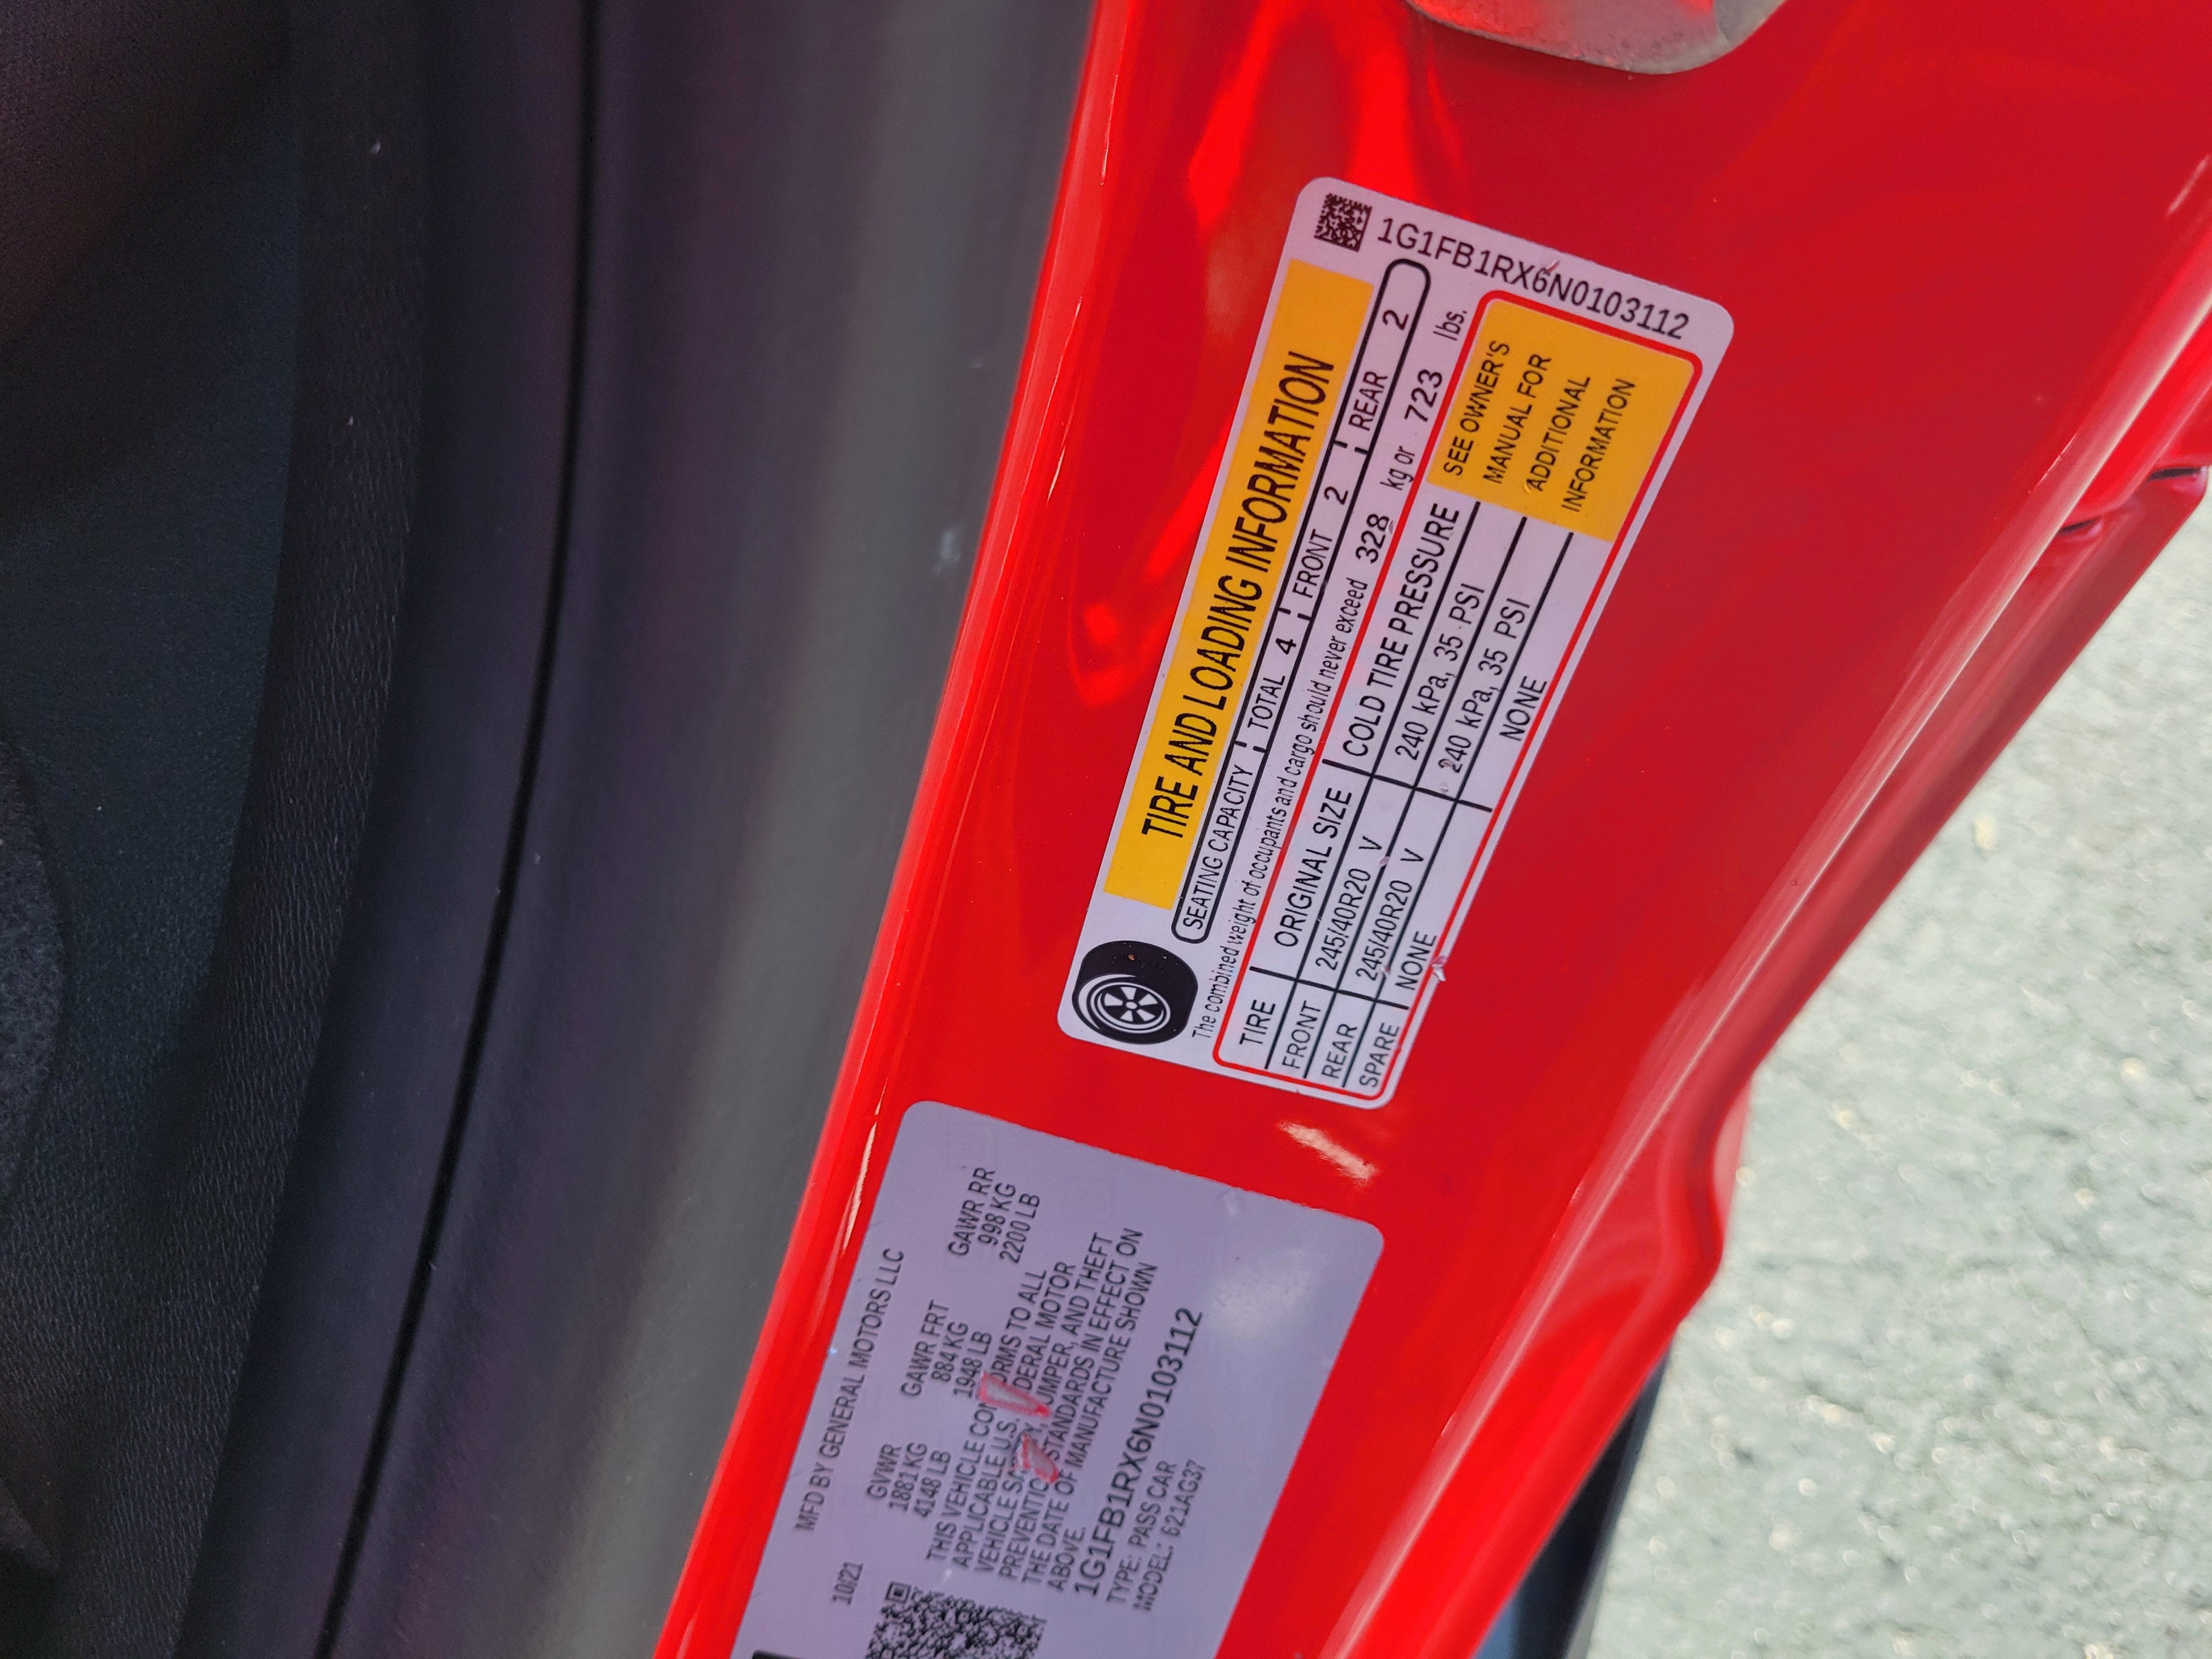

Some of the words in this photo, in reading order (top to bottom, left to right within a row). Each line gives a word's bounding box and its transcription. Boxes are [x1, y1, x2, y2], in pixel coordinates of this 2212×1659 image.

[1378, 218, 1689, 340] 1G1FB1RX6N0103112
[1433, 311, 1467, 341] lbs.
[1348, 371, 1388, 431] REAR
[1383, 310, 1409, 330] 2
[1404, 369, 1442, 422] 723
[1443, 437, 1474, 476] SEE
[1460, 341, 1509, 432] OWNER'S
[1483, 405, 1532, 484] MANUAL
[1517, 354, 1551, 398] FOR
[1526, 377, 1590, 491] ADDITIONAL
[1226, 351, 1334, 572] INFORMATION
[1394, 446, 1415, 464] or
[1561, 379, 1635, 512] INFORMATION
[1380, 469, 1413, 490] kg
[1293, 529, 1332, 598] FRONT
[1324, 487, 1348, 505] 2
[1356, 514, 1392, 563] 328
[1335, 578, 1368, 633] exceed
[1343, 696, 1385, 756] COLD
[1367, 637, 1408, 687] TIRE
[1388, 504, 1459, 635] PRESSURE
[1448, 584, 1485, 624] PSI
[1494, 599, 1530, 639] PSI
[1183, 575, 1262, 710] LOADING
[1319, 636, 1347, 679] never
[1434, 634, 1463, 661] 35
[1478, 648, 1508, 675] 35
[1248, 676, 1285, 729] TOTAL
[1276, 638, 1296, 654] 4
[1298, 680, 1331, 732] should
[1412, 672, 1459, 719] kPa,
[1455, 686, 1504, 732] kPa,
[1499, 676, 1547, 741] NONE
[1164, 713, 1217, 776] AND
[1285, 735, 1314, 775] cargo
[1395, 722, 1428, 760] 240
[1438, 735, 1471, 773] 240
[1142, 776, 1198, 838] TIRE
[1276, 776, 1297, 806] and
[1183, 856, 1223, 929] SEATING
[1208, 764, 1252, 852] CAPACITY
[1249, 808, 1286, 879] occupants
[1274, 847, 1332, 946] ORIGINAL
[1313, 788, 1352, 838] SIZE
[1242, 881, 1261, 896] of
[1316, 868, 1370, 970] 245/40R20
[1358, 836, 1382, 850] V
[1356, 881, 1412, 981] 245/40R20
[1401, 848, 1424, 861] V
[1227, 899, 1256, 944] weight
[1205, 946, 1239, 1012] combined
[1395, 932, 1436, 990] NONE
[1192, 1016, 1216, 1037] The
[1239, 1000, 1276, 1045] TIRE
[1282, 1001, 1321, 1069] FRONT
[1321, 1024, 1357, 1078] REAR
[1359, 1023, 1399, 1087] SPARE
[948, 1200, 984, 1256] GAWR
[968, 1168, 995, 1195] RR
[990, 1183, 1015, 1211] KG
[978, 1213, 1006, 1245] 998
[1000, 1221, 1030, 1263] 2200
[1015, 1194, 1040, 1218] LB
[1116, 1228, 1143, 1256] ON
[876, 1249, 904, 1285] LLC
[1018, 1271, 1046, 1304] ALL
[1074, 1232, 1112, 1290] THEFT
[1006, 1307, 1031, 1329] TO
[1035, 1262, 1075, 1329] MOTOR
[1061, 1296, 1090, 1335] AND
[1088, 1260, 1129, 1331] EFFECT
[1115, 1262, 1157, 1330] SHOWN
[849, 1289, 891, 1368] MOTORS
[901, 1341, 936, 1397] GAWR
[921, 1300, 949, 1336] FRT
[943, 1322, 968, 1349] KG
[1077, 1333, 1104, 1352] IN
[931, 1351, 958, 1382] 884
[953, 1358, 983, 1398] 1948
[968, 1331, 992, 1355] LB
[1004, 1331, 1049, 1410] DERAL
[1030, 1336, 1078, 1417] UMPER,
[819, 1375, 865, 1458] GENERAL
[1042, 1356, 1094, 1461] STANDARDS
[1064, 1334, 1131, 1468] MANUFACTURE
[903, 1443, 927, 1469] KG
[991, 1419, 1019, 1453] U.S.
[1074, 1308, 1201, 1596] 1G1FB1RX6N0103112
[809, 1463, 833, 1488] BY
[866, 1444, 901, 1499] GVWR
[889, 1472, 918, 1511] 1881
[913, 1477, 941, 1517] 4148
[927, 1451, 951, 1475] LB
[941, 1441, 985, 1516] VEHICLE
[1054, 1469, 1077, 1495] OF
[795, 1492, 825, 1530] MFD
[952, 1455, 1007, 1568] APPLICABLE
[975, 1497, 1018, 1572] VEHICLE
[997, 1463, 1057, 1579] PREVENTIO
[1036, 1499, 1069, 1547] DATE
[1106, 1555, 1141, 1602] TYPE:
[1128, 1502, 1161, 1548] PASS
[1147, 1461, 1177, 1499] CAR
[1133, 1543, 1173, 1611] MODEL:
[1160, 1459, 1205, 1537] 621AG37
[926, 1522, 957, 1559] THIS
[1022, 1549, 1051, 1582] THE
[1048, 1528, 1086, 1592] ABOVE.
[833, 1562, 863, 1605] 10/21
